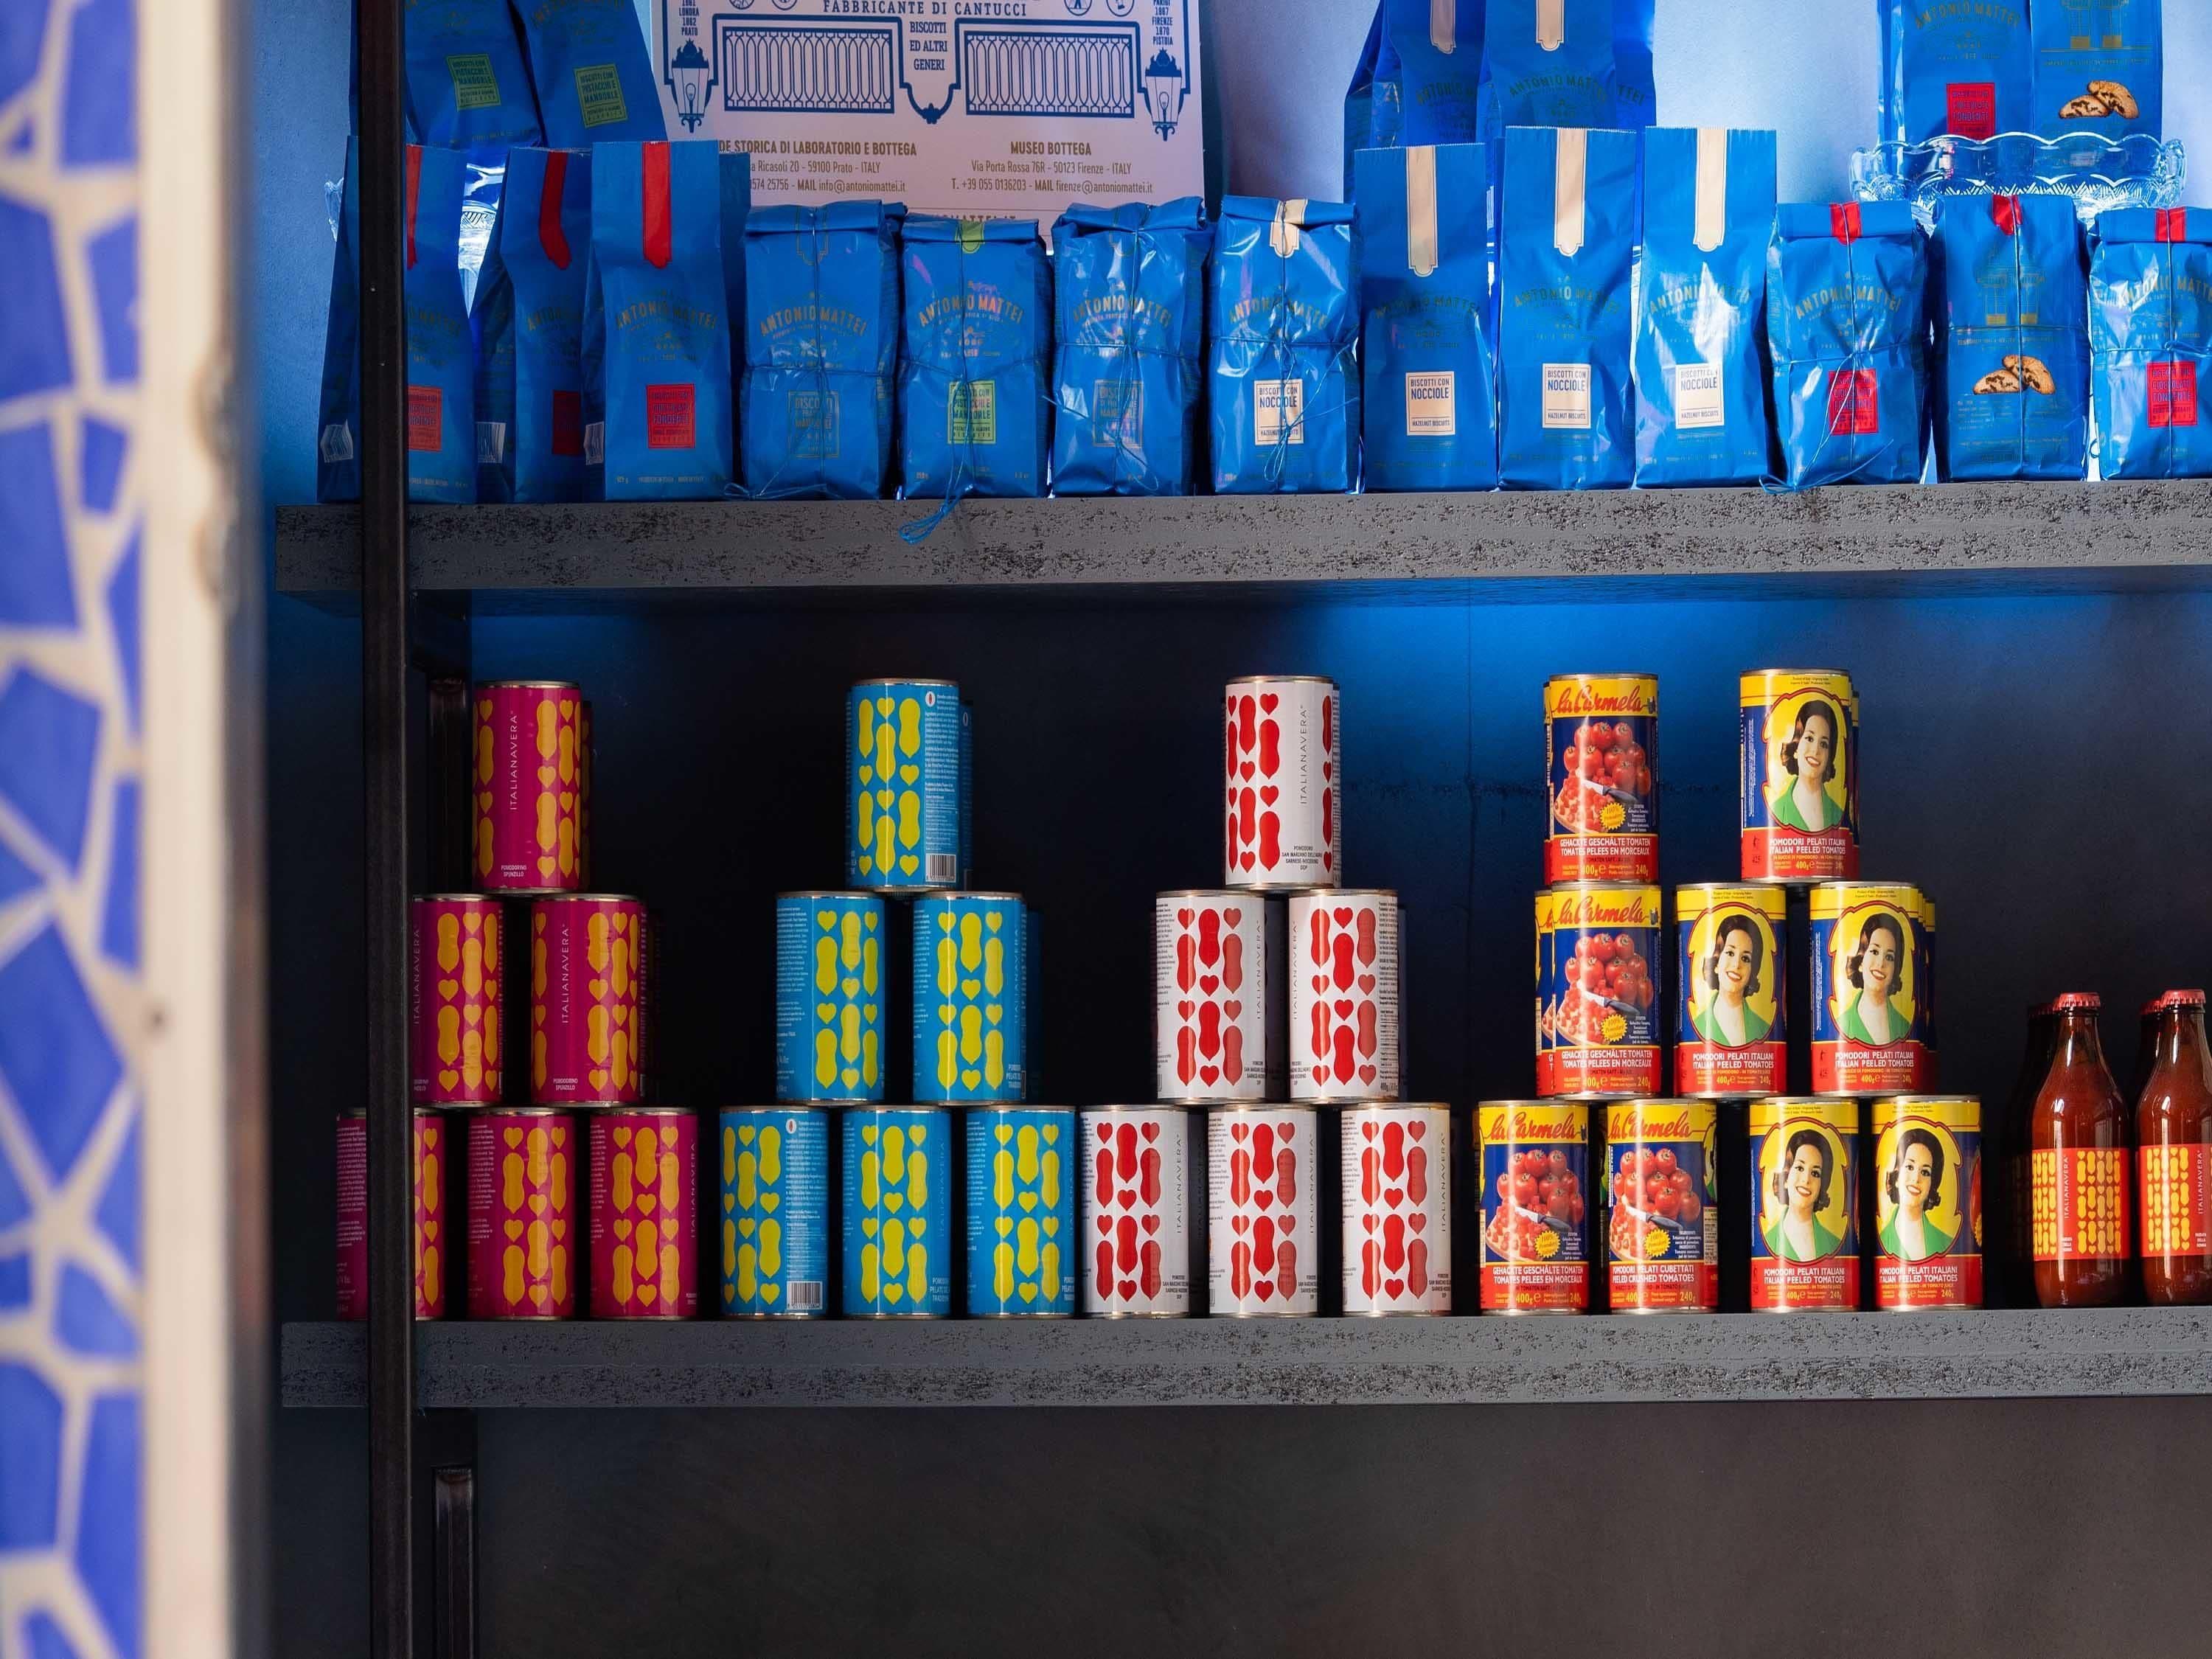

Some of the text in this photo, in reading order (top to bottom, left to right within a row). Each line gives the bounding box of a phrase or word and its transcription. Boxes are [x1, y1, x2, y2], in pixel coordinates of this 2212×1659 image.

[824, 0, 1026, 16] FABBRICANTE DI CANTUCCI
[1152, 17, 1173, 26] FIRENZE
[681, 27, 698, 36] PRATO
[910, 21, 947, 33] BISCOTTI
[1153, 36, 1173, 45] PISTOIA
[910, 40, 947, 52] ED ALTRI
[914, 58, 945, 71] GENERI
[734, 140, 917, 156] STORICA DI LABORATORIO E BOTTEGA
[1010, 141, 1091, 156] MUSEO BOTTEGA
[758, 160, 787, 172] Ricasoli
[790, 161, 799, 172] 20
[808, 161, 830, 173] 59100
[833, 161, 852, 173] Prato
[861, 161, 880, 173] ITALY
[971, 159, 1133, 175] Via Porta Rossa 76R 50123 Firenze ITALY
[768, 178, 789, 190] 25756
[798, 179, 817, 190] MAIL
[819, 179, 905, 194] info@antoniomattei.it
[952, 178, 959, 189] T.
[961, 178, 976, 189] +39
[978, 178, 992, 190] 055
[1034, 180, 1054, 191] MAIL
[1056, 181, 1152, 195] firenze@antoniomattei.it
[1548, 370, 1586, 378] BISCOTTI CON
[1411, 378, 1450, 387] BISCOTTI CON
[1548, 379, 1585, 391] NOCCIOLE
[1680, 377, 1717, 391] NOCCIOLE
[1259, 386, 1298, 396] BISCOT CON
[1411, 387, 1450, 400] NOCCIOLE
[1259, 396, 1298, 408] NOCCOLE
[509, 714, 518, 810] ITALIANAVERA
[1627, 838, 1651, 846] TOMATEN
[1770, 838, 1827, 846] POMODORI PELATI
[1561, 847, 1585, 856] TOMATES
[1610, 847, 1620, 855] EN
[1620, 847, 1650, 855] MORCEAUX
[1770, 846, 1820, 854] ITALIAN PEELED
[1574, 895, 1645, 924] Carmela
[1627, 1050, 1652, 1058] TOMATEN
[1693, 1052, 1774, 1060] POMODORI PELATI ITALIANI
[1834, 1051, 1869, 1060] POMODORI
[1872, 1051, 1893, 1060] PELATI
[1611, 1059, 1621, 1068] EN
[1621, 1059, 1652, 1068] MORCEAUX
[1693, 1060, 1774, 1069] ITALIAN PEELED TOMATOES
[1834, 1060, 1859, 1068] ITALIAN
[1862, 1060, 1886, 1068] PEELED
[1507, 1111, 1577, 1140] Carmela
[1622, 1110, 1692, 1138] Carmela
[1561, 1267, 1583, 1275] TOMATEN
[1660, 1265, 1694, 1273] CUBETTATI
[1764, 1267, 1845, 1276] POMODORI PELATI ITALIANI
[1907, 1266, 1930, 1274] PELATI
[1931, 1266, 1958, 1274] ITALIANI
[1494, 1276, 1520, 1284] TOMATES
[1545, 1276, 1554, 1284] EN
[1555, 1276, 1582, 1284] MORCEAUX
[1628, 1274, 1694, 1283] CRUSHED TOMATOES
[1787, 1276, 1812, 1284] PEELED
[1814, 1276, 1845, 1284] TOMATOES
[1898, 1274, 1958, 1283] PEELED TOMATOES
